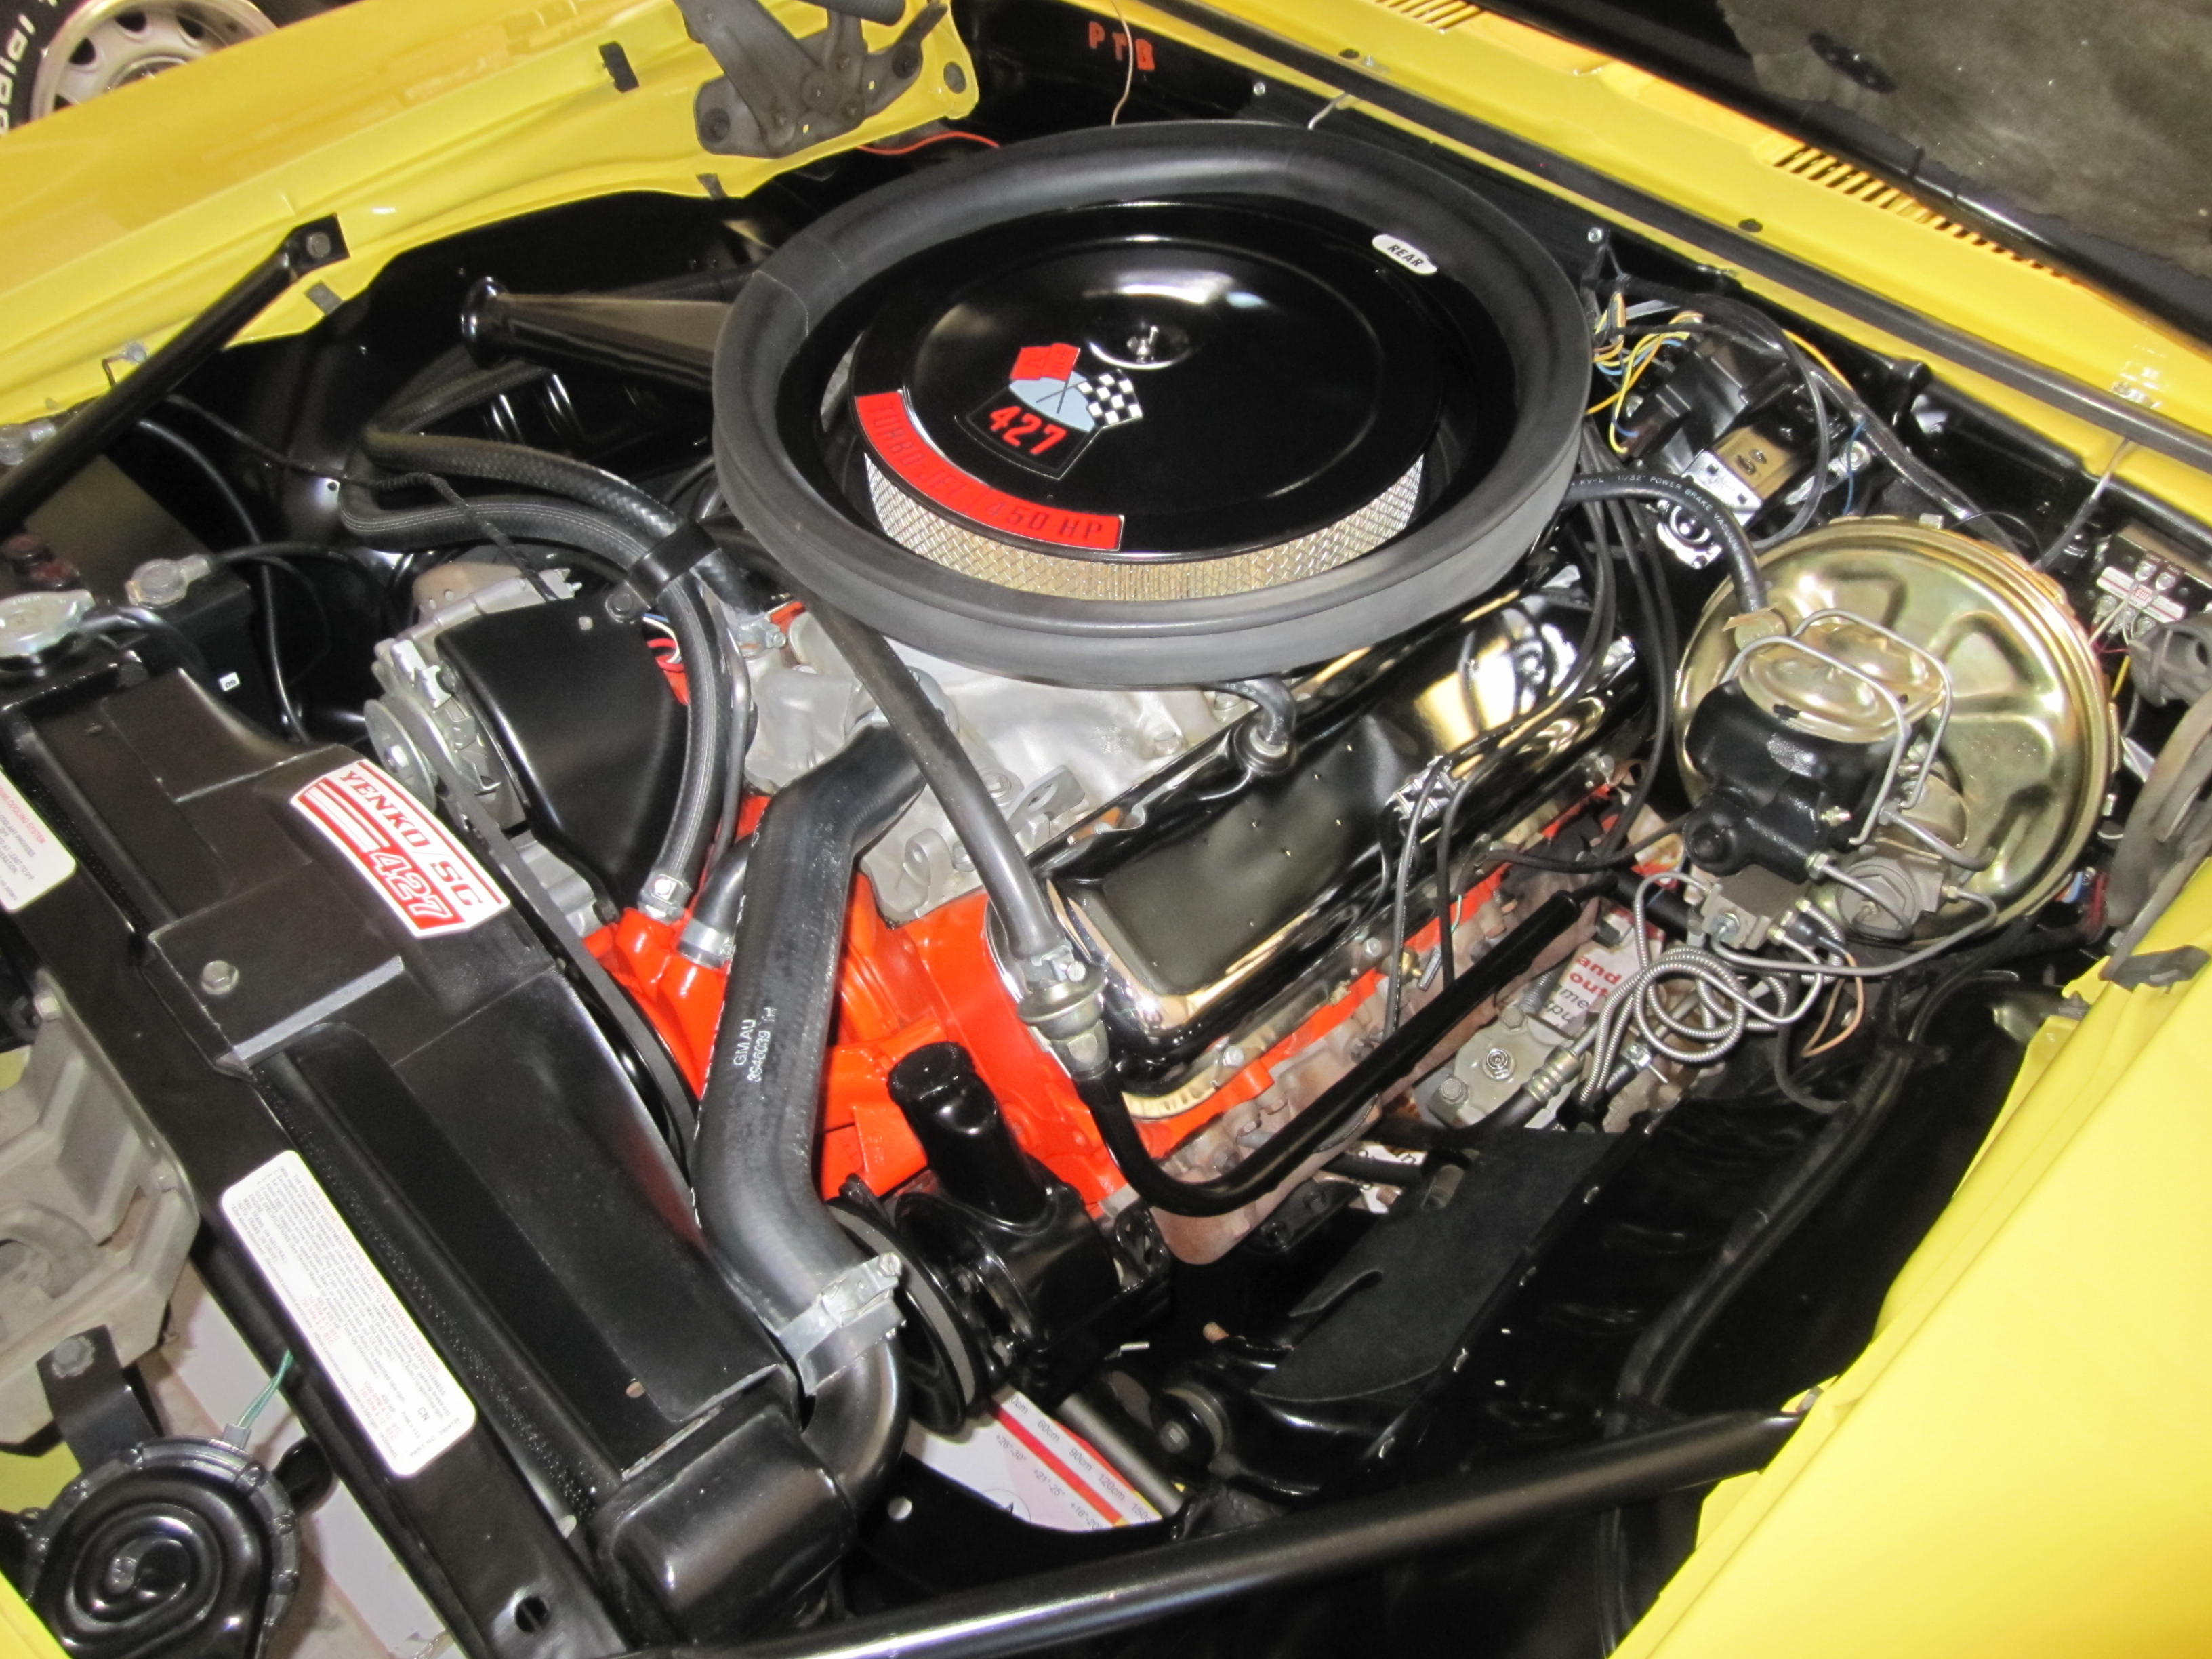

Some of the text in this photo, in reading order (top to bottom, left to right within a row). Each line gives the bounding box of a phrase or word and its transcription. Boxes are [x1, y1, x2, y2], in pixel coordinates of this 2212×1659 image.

[1387, 244, 1424, 267] REAR
[990, 405, 1067, 455] 427
[869, 403, 1104, 541] TURBO-JET 450 HP
[1650, 475, 1683, 491] POWER
[1684, 488, 1713, 512] BRAKE
[369, 851, 455, 920] 427
[1576, 957, 1622, 985] and
[369, 1273, 393, 1304] REDUCE
[388, 1301, 414, 1334] EXHAUST
[411, 1333, 441, 1373] EMISSIONS
[413, 1350, 447, 1397] EFFECTIVENESS
[416, 1405, 430, 1422] CN
[1037, 1420, 1061, 1443] 60cm
[1069, 1447, 1092, 1471] 90cm
[1099, 1473, 1126, 1501] 120cm
